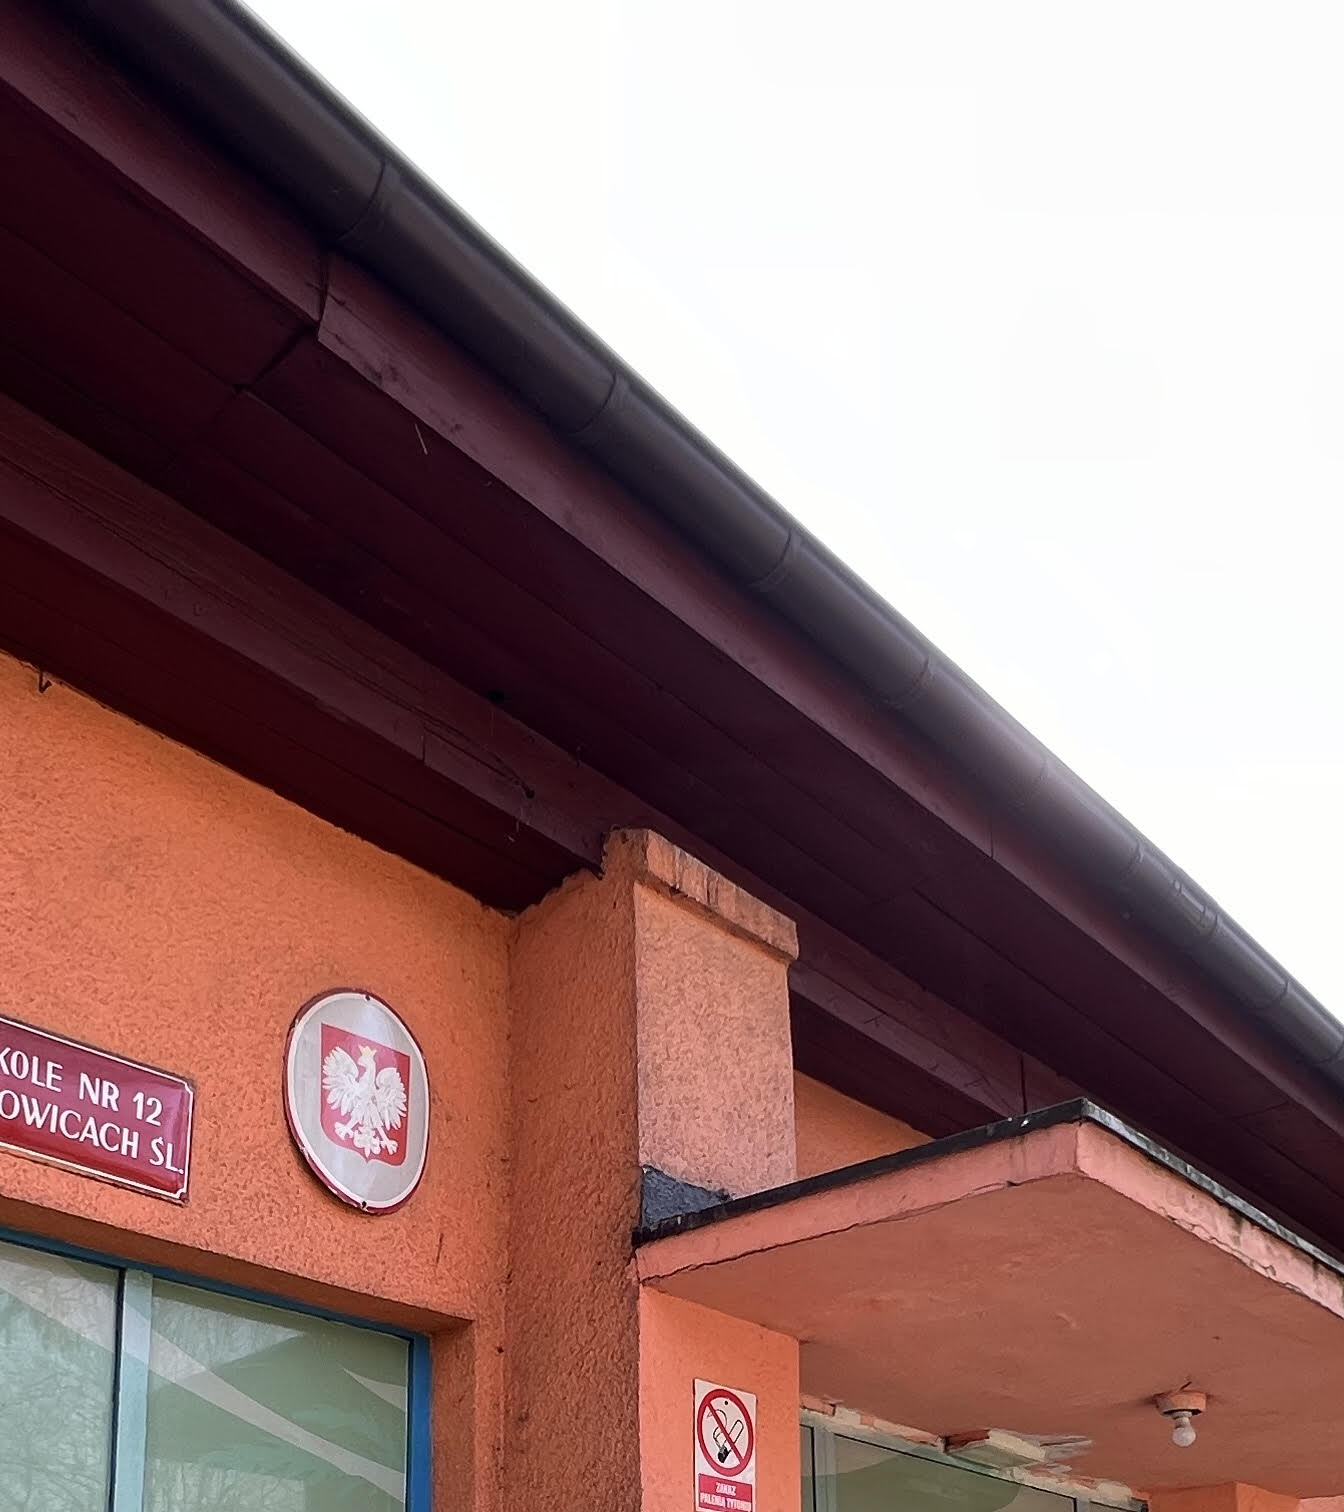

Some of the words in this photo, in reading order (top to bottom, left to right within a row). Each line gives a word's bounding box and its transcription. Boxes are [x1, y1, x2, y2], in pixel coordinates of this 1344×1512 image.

[78, 1072, 120, 1112] NR
[132, 1091, 163, 1126] 12
[149, 1135, 185, 1175] ŚL.
